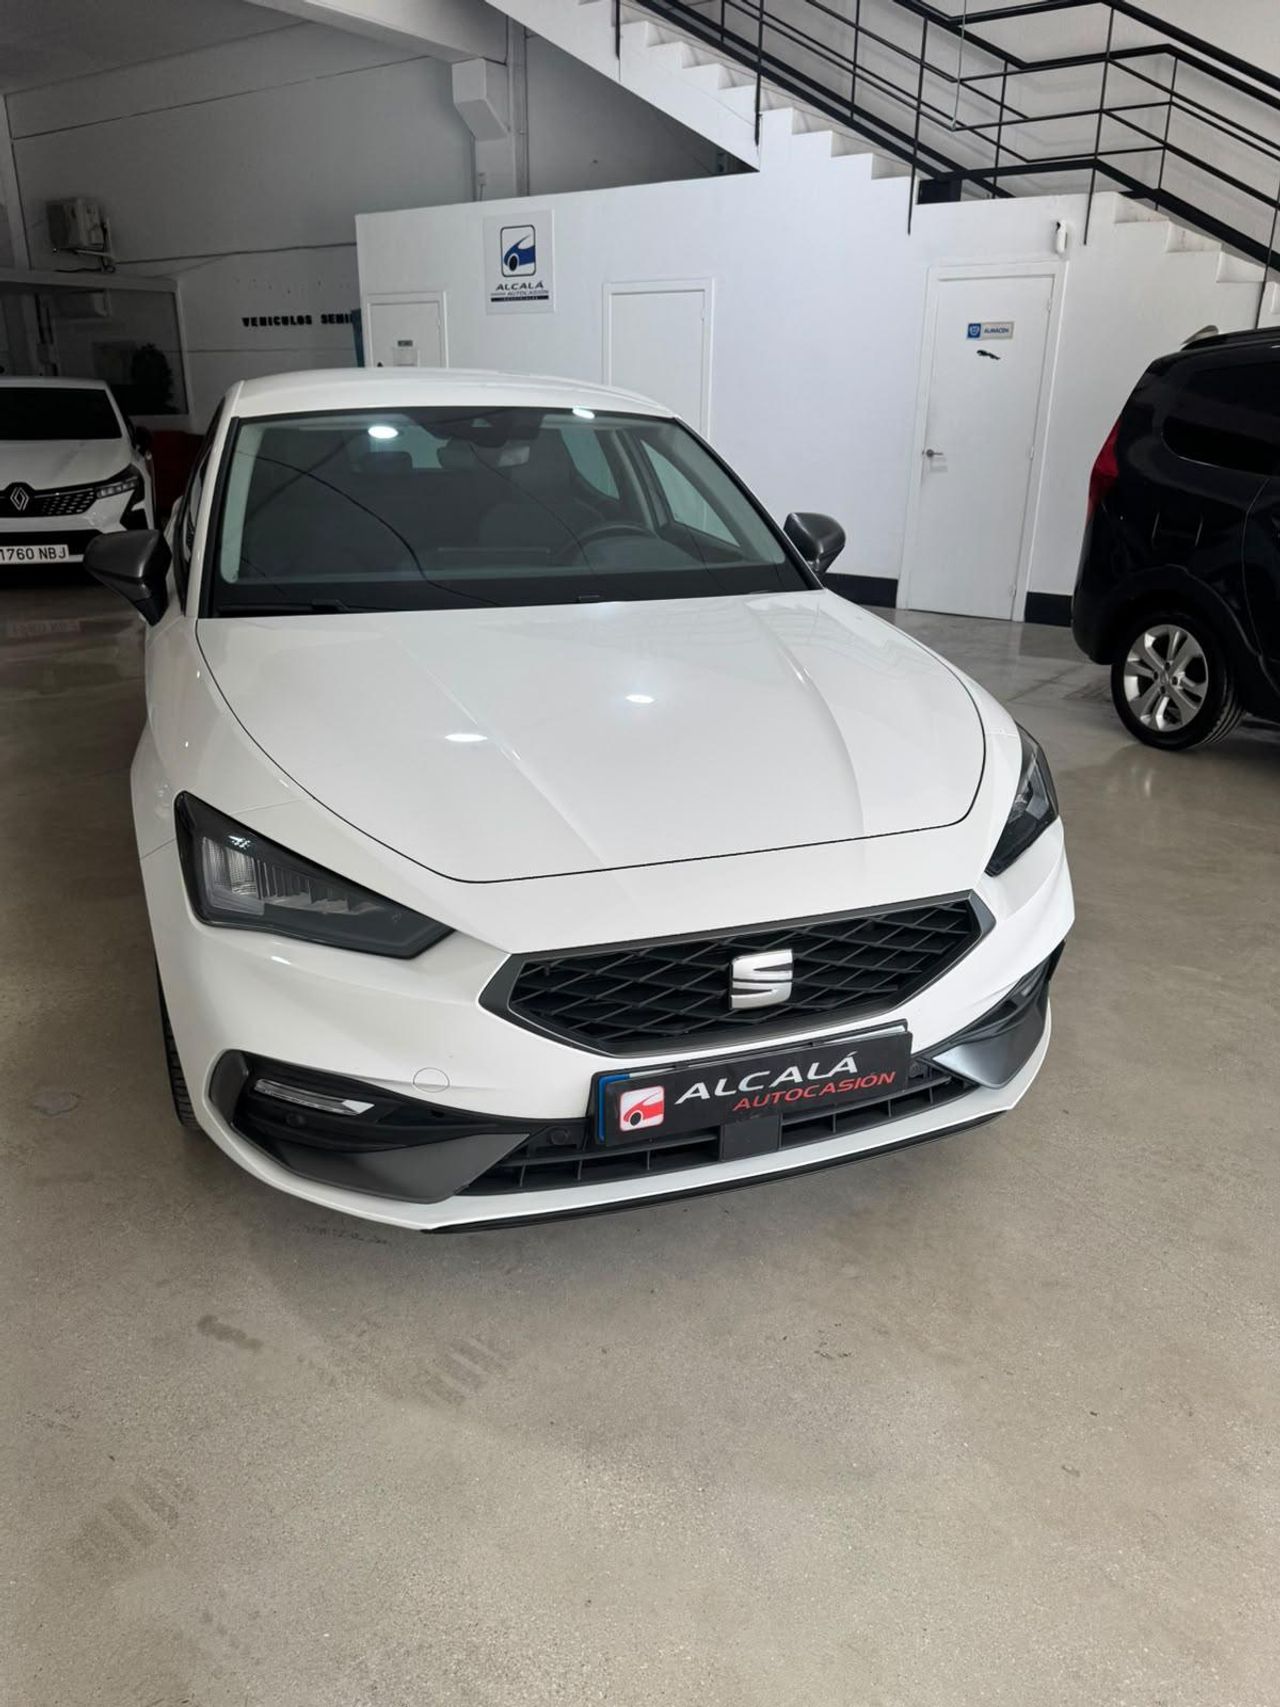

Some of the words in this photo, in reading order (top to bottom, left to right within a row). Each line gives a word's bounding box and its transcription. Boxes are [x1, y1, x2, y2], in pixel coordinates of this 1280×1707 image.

[0, 547, 35, 561] 1760
[38, 547, 66, 560] NBJ
[675, 1051, 858, 1104] ALCALÁ
[733, 1072, 896, 1112] AUTOCASIÓN
